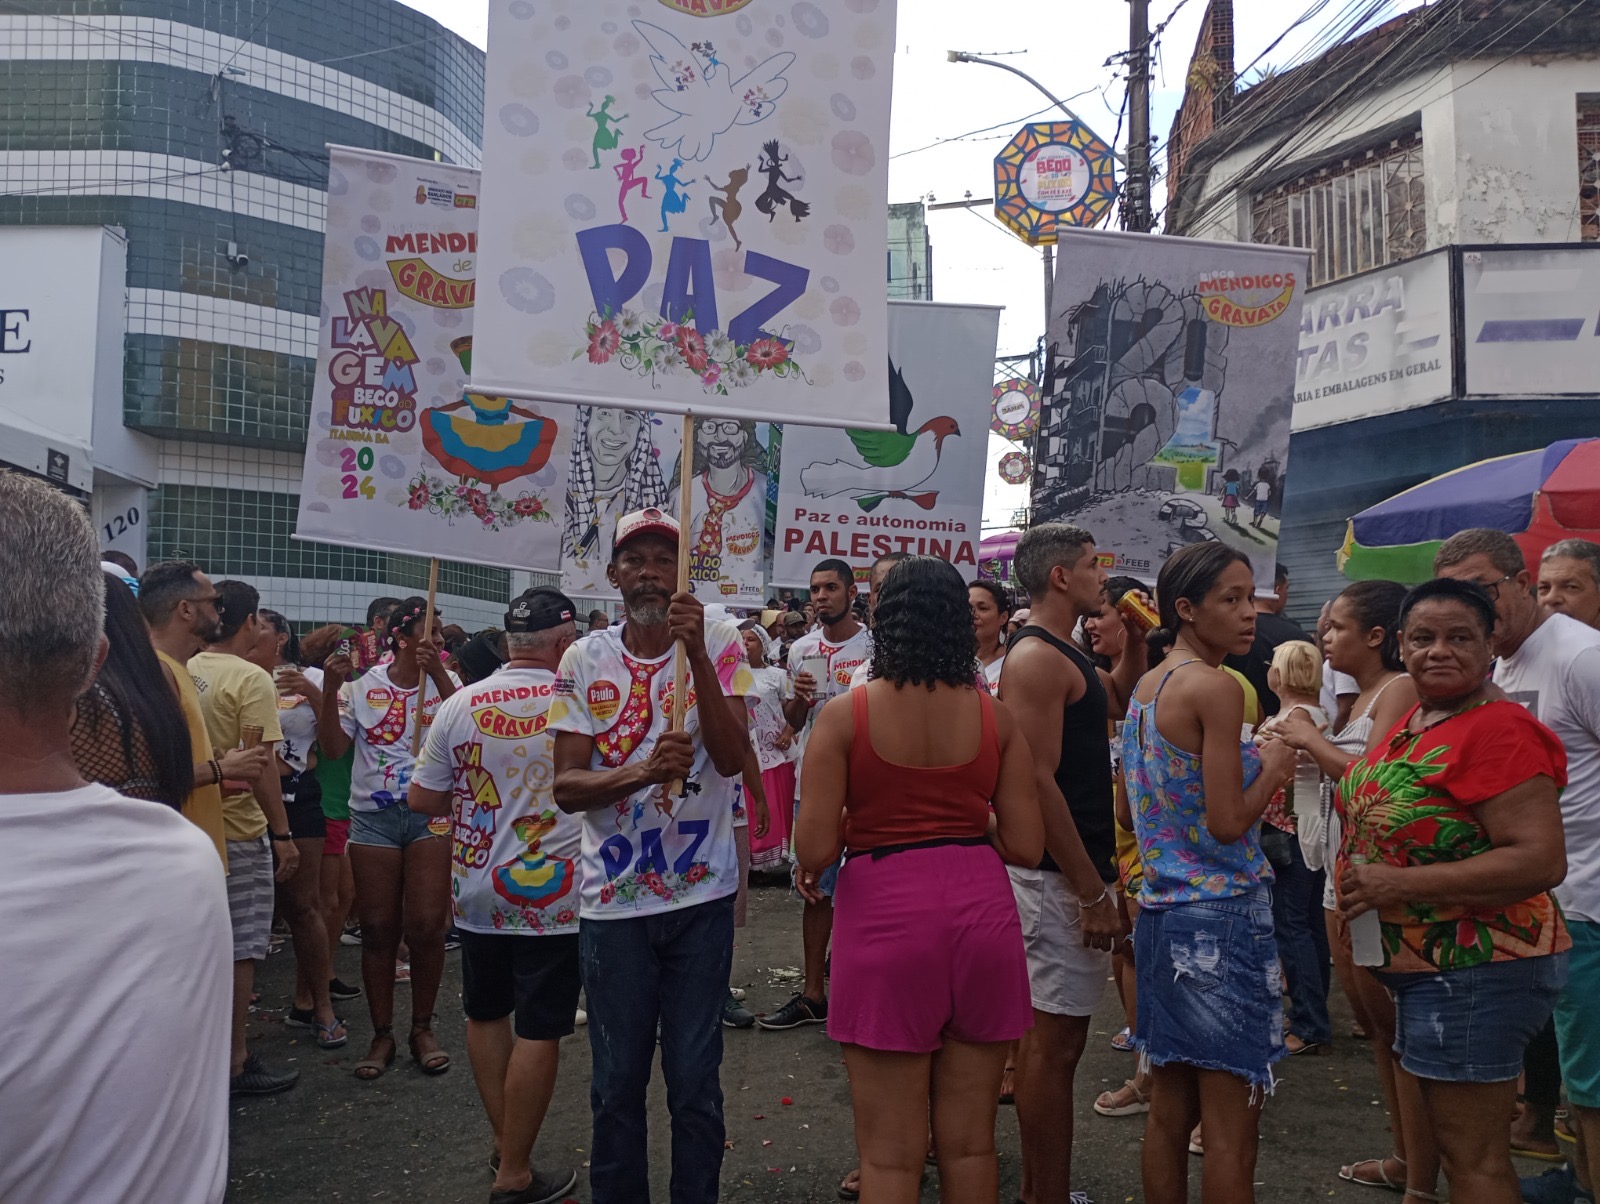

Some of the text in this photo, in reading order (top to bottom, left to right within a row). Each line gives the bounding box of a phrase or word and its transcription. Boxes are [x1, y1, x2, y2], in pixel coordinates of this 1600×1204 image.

[386, 232, 478, 254] MENDI
[453, 258, 472, 272] de
[576, 224, 810, 353] PAZ
[1199, 273, 1296, 293] MENDIGOS
[347, 288, 386, 318] NA
[1209, 298, 1286, 325] GRAVATA
[335, 316, 417, 362] LAVA
[332, 353, 416, 394] GEM
[1315, 388, 1322, 400] E
[1323, 372, 1387, 398] EMBALAGENS
[1389, 367, 1404, 381] EM
[1406, 358, 1441, 377] GERAL
[354, 387, 399, 407] BECO
[334, 399, 413, 428] FUXICO
[375, 432, 390, 444] BA
[340, 446, 374, 472] 20
[341, 474, 376, 500] 24
[104, 506, 140, 544] 120
[795, 508, 966, 533] Paz e autonomia
[726, 531, 760, 542] MENDIGOS
[784, 528, 977, 566] PALESTINA
[703, 556, 721, 569] DO
[1125, 558, 1150, 567] FEEB
[854, 570, 871, 579] CT
[721, 586, 737, 594] CTB
[370, 691, 388, 700] Paulo
[590, 687, 614, 702] Paulo
[455, 825, 482, 847] BECO
[599, 819, 710, 883] PAZ
